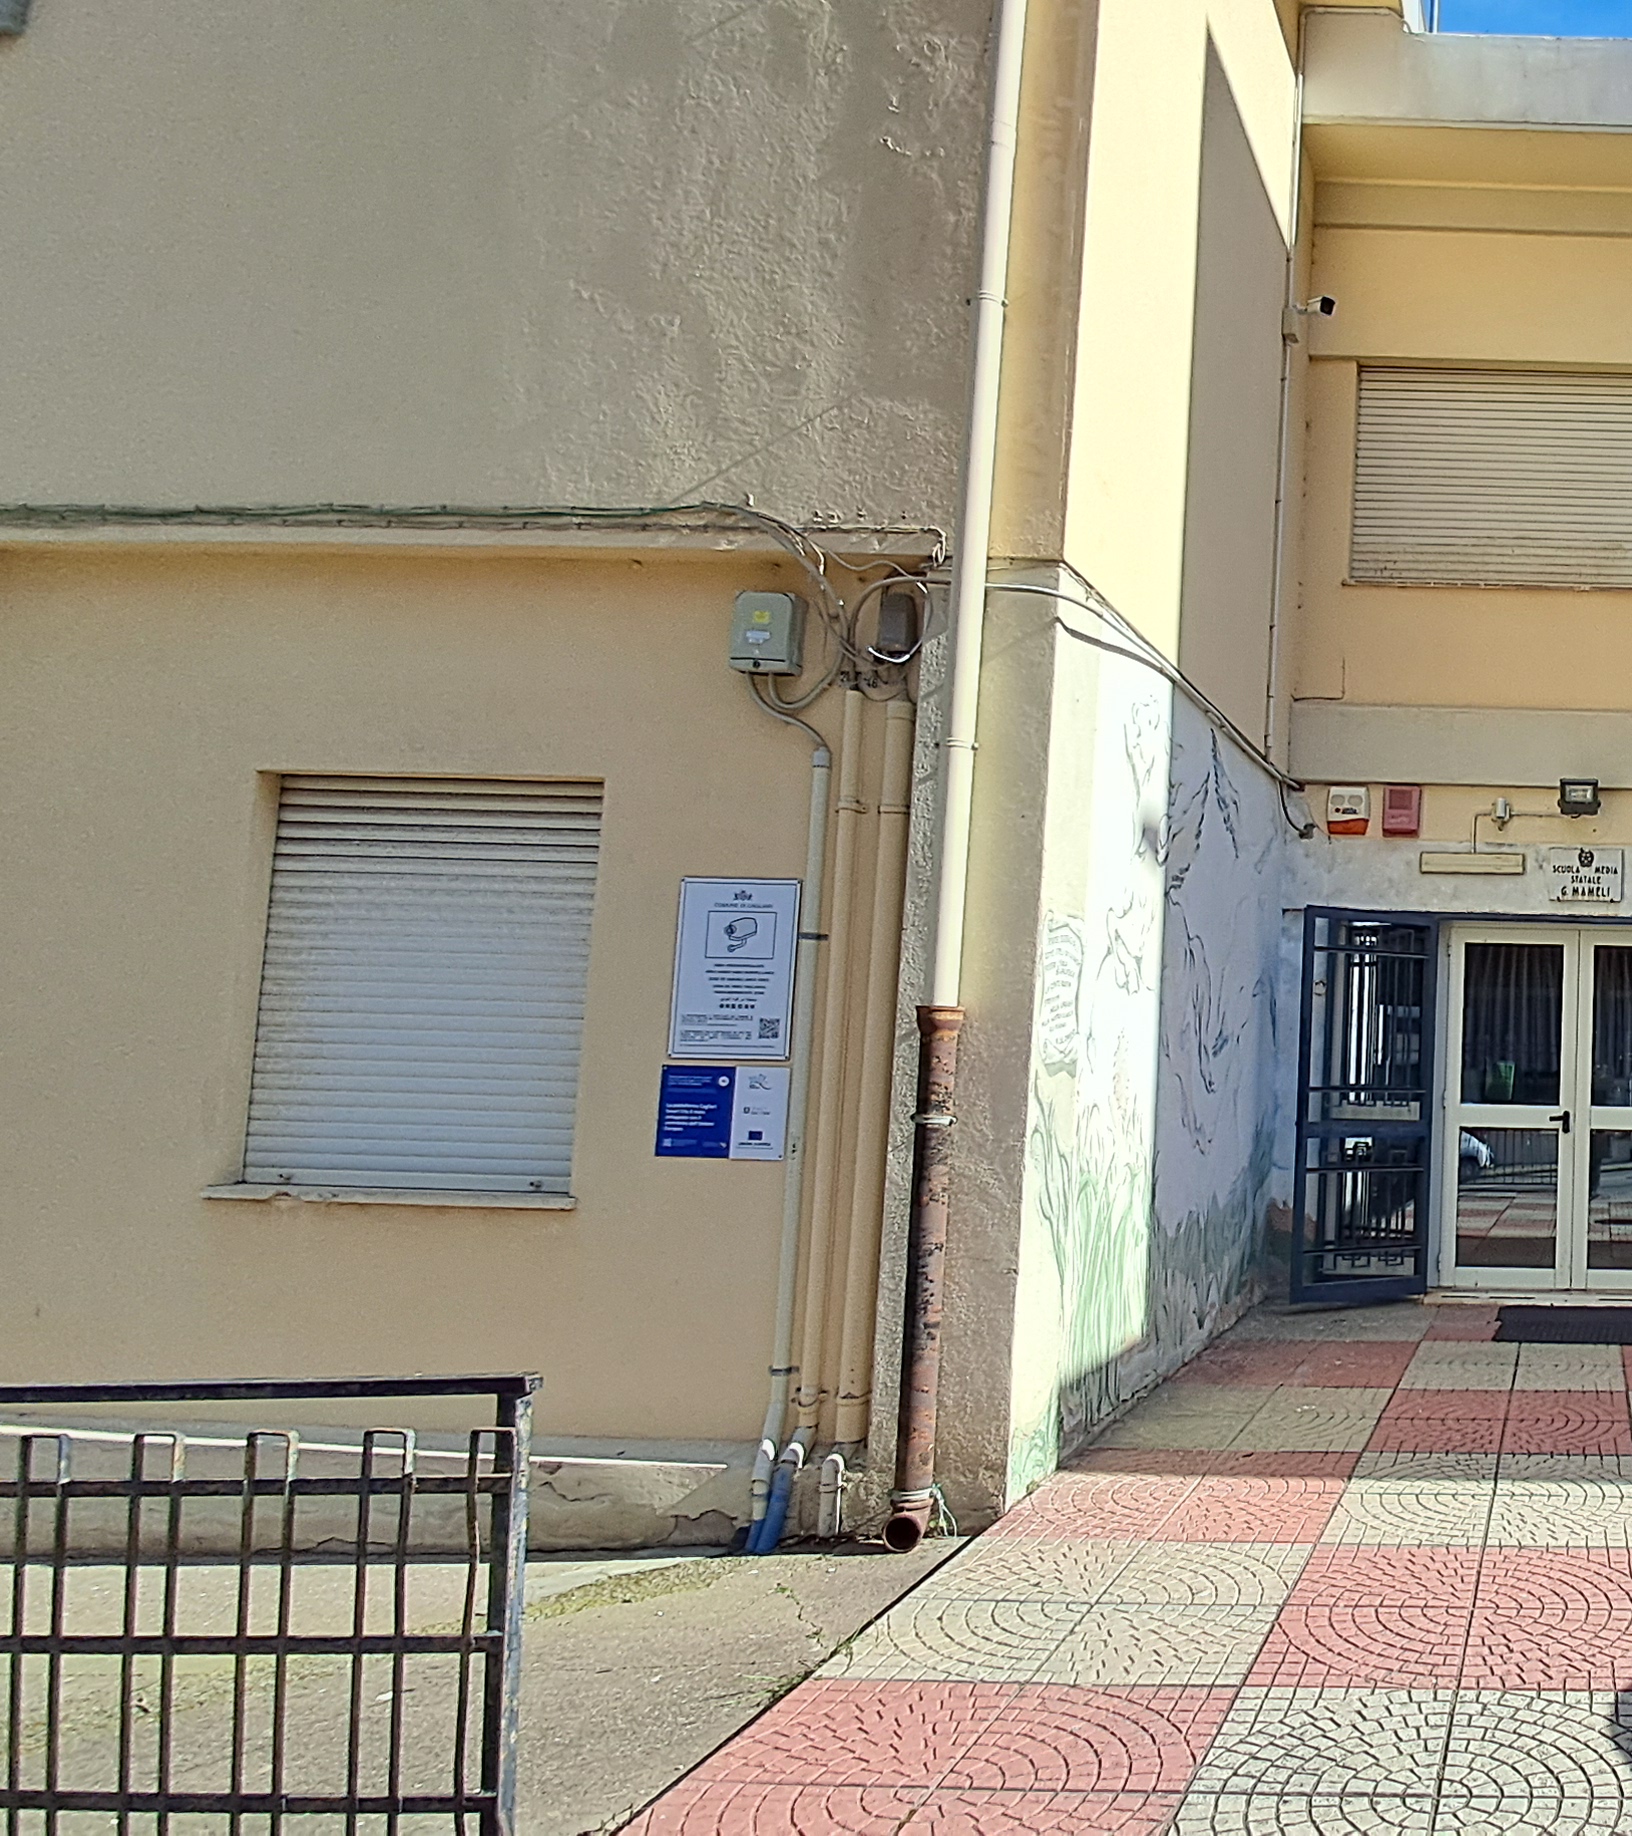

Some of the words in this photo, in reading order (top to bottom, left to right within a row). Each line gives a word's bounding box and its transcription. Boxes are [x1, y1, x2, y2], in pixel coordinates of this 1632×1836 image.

[1552, 865, 1580, 874] SCUOLA
[1595, 866, 1618, 875] MEDIA
[1571, 875, 1601, 885] STATALE
[1572, 886, 1610, 898] MAMELI
